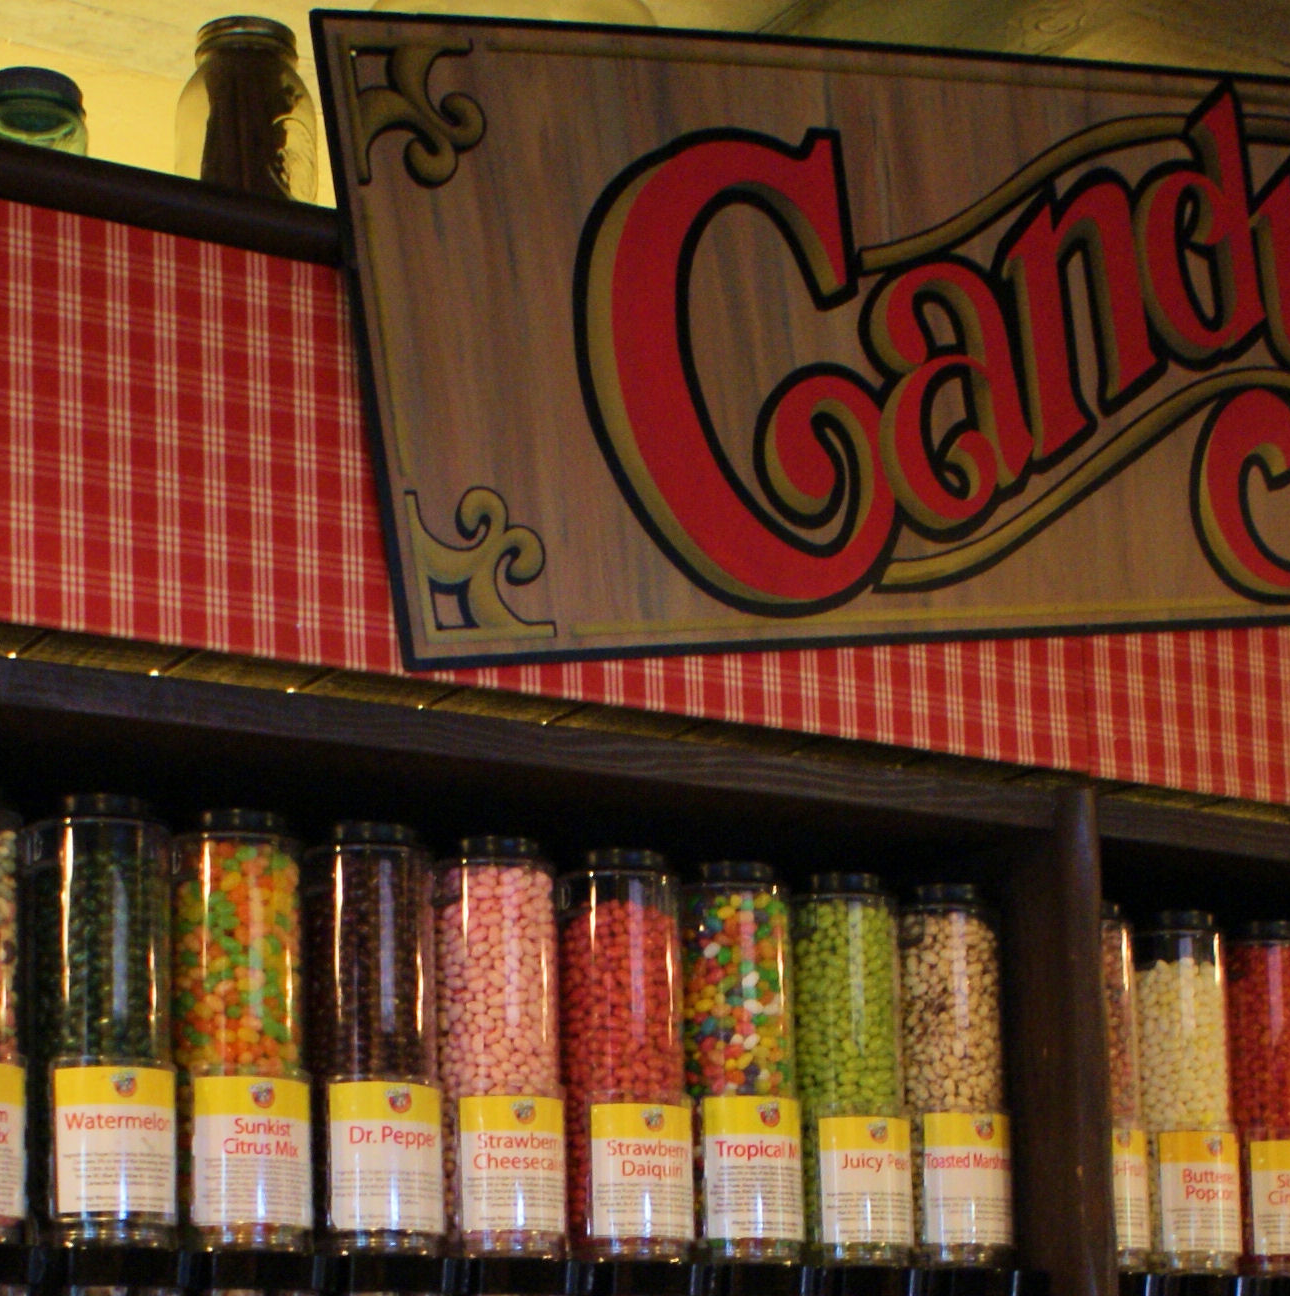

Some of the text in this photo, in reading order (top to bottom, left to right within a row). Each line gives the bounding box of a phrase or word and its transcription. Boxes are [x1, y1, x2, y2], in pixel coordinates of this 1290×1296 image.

[234, 1117, 292, 1137] Sunkist
[349, 1125, 377, 1145] Dr.
[222, 1137, 299, 1158] Citrus Mix
[715, 1140, 785, 1161] Tropical
[841, 1153, 884, 1173] Juicy
[925, 1151, 970, 1169] Toasted
